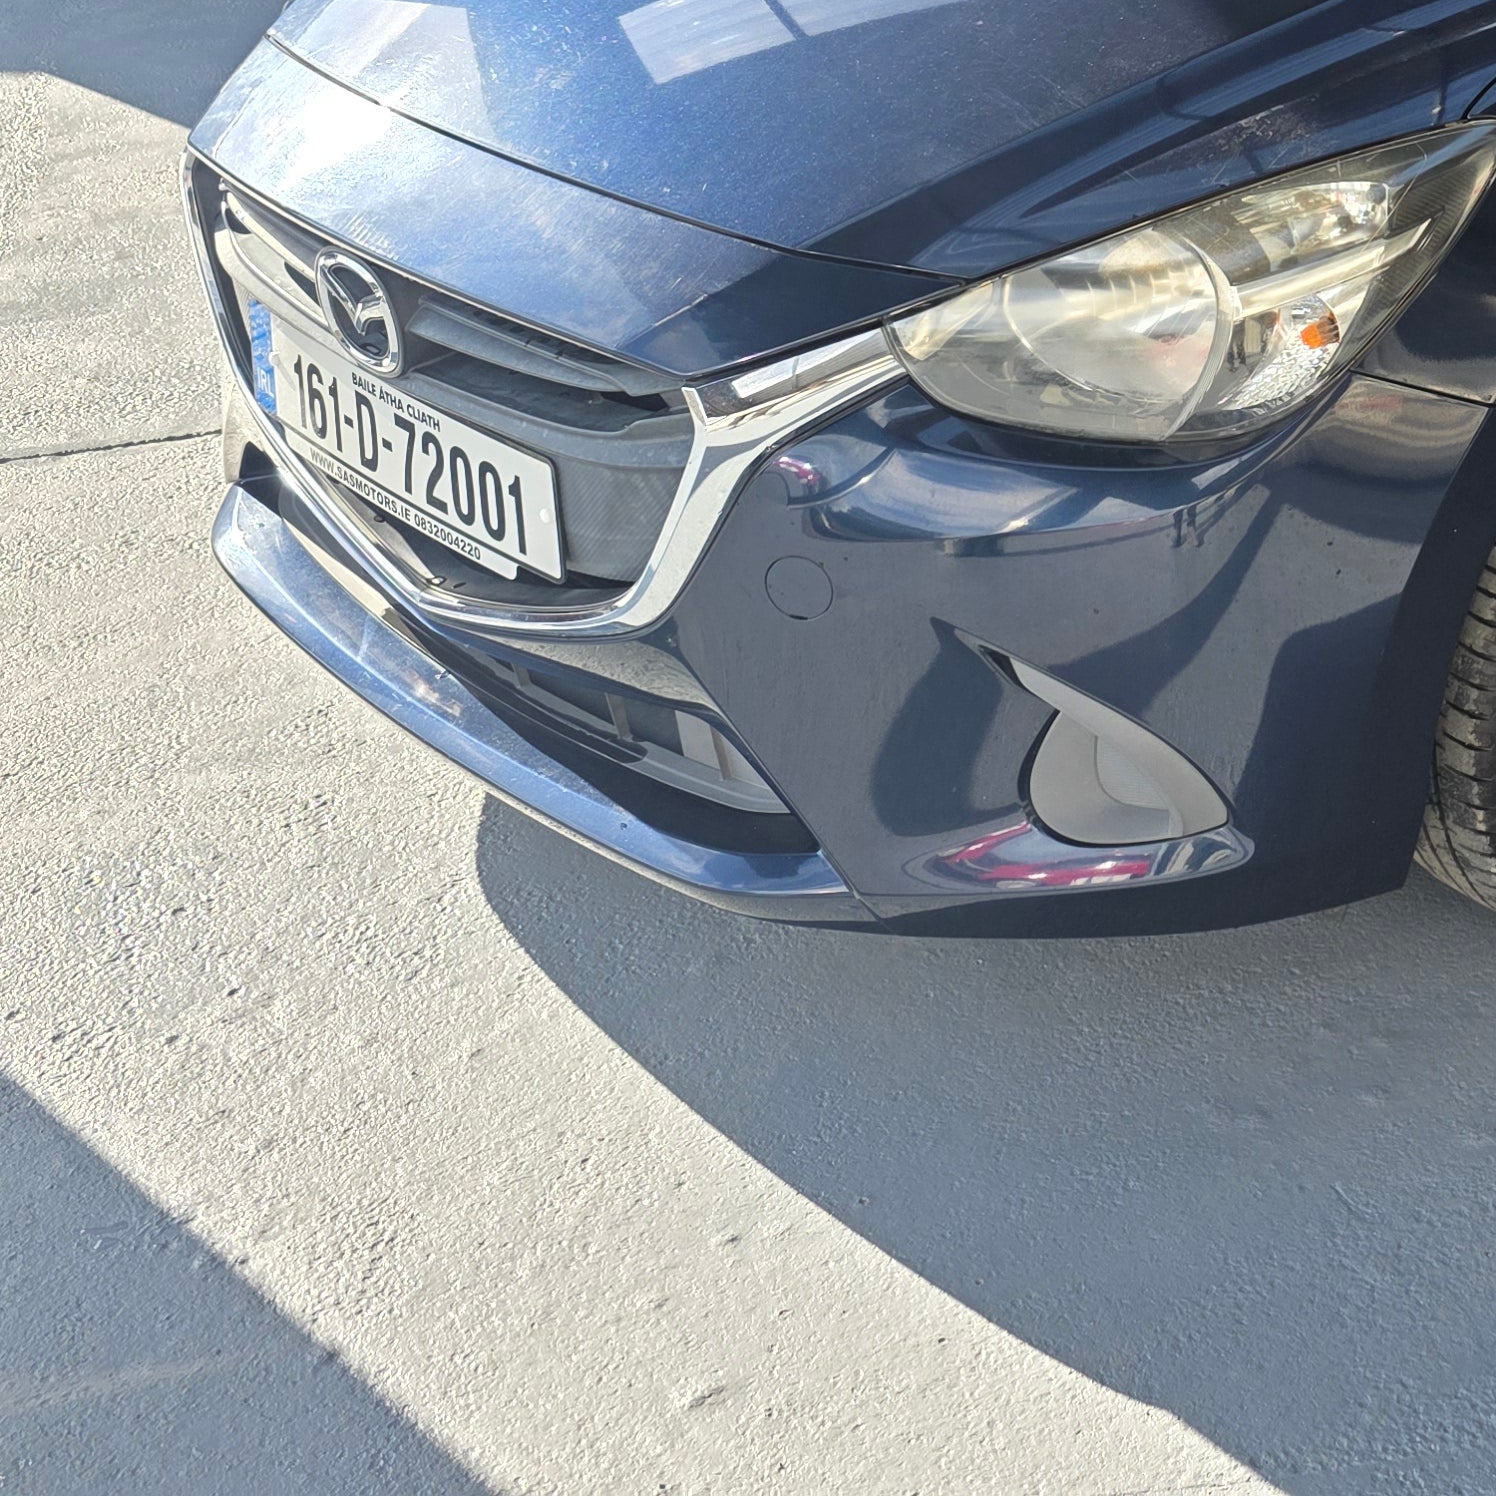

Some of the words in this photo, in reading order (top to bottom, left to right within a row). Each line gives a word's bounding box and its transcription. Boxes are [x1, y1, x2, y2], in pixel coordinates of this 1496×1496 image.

[294, 354, 527, 556] 161-D-72001
[352, 372, 377, 397] BAILE
[406, 404, 441, 432] CLIATH
[310, 447, 411, 522] WWW.SASMOTORS.IE
[414, 512, 482, 560] 0832004220
